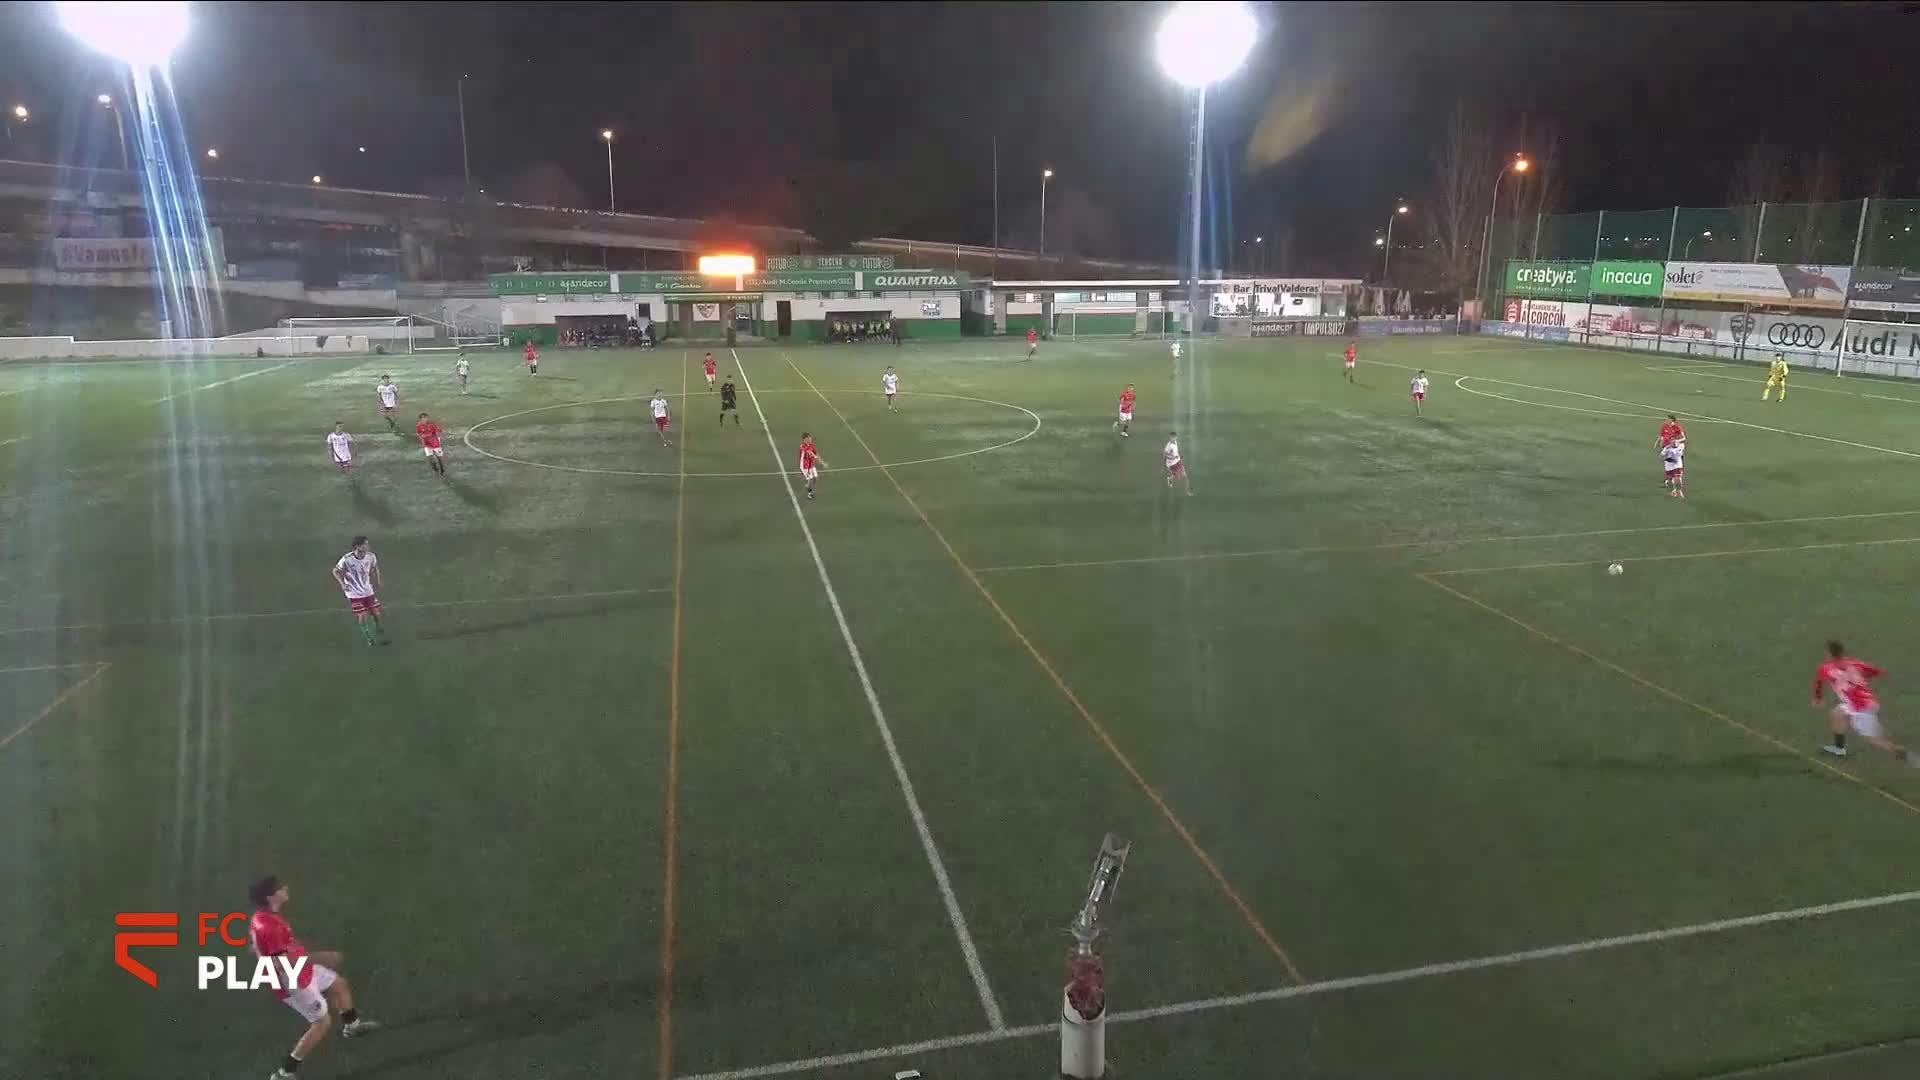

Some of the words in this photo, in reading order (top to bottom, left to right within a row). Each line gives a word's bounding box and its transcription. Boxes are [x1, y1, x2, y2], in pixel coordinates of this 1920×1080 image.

[874, 275, 957, 286] QUAMTRAX
[1602, 267, 1652, 285] inacua
[1233, 284, 1250, 293] Bar
[1521, 308, 1567, 327] ALCORCÓN
[1830, 328, 1897, 356] Audi
